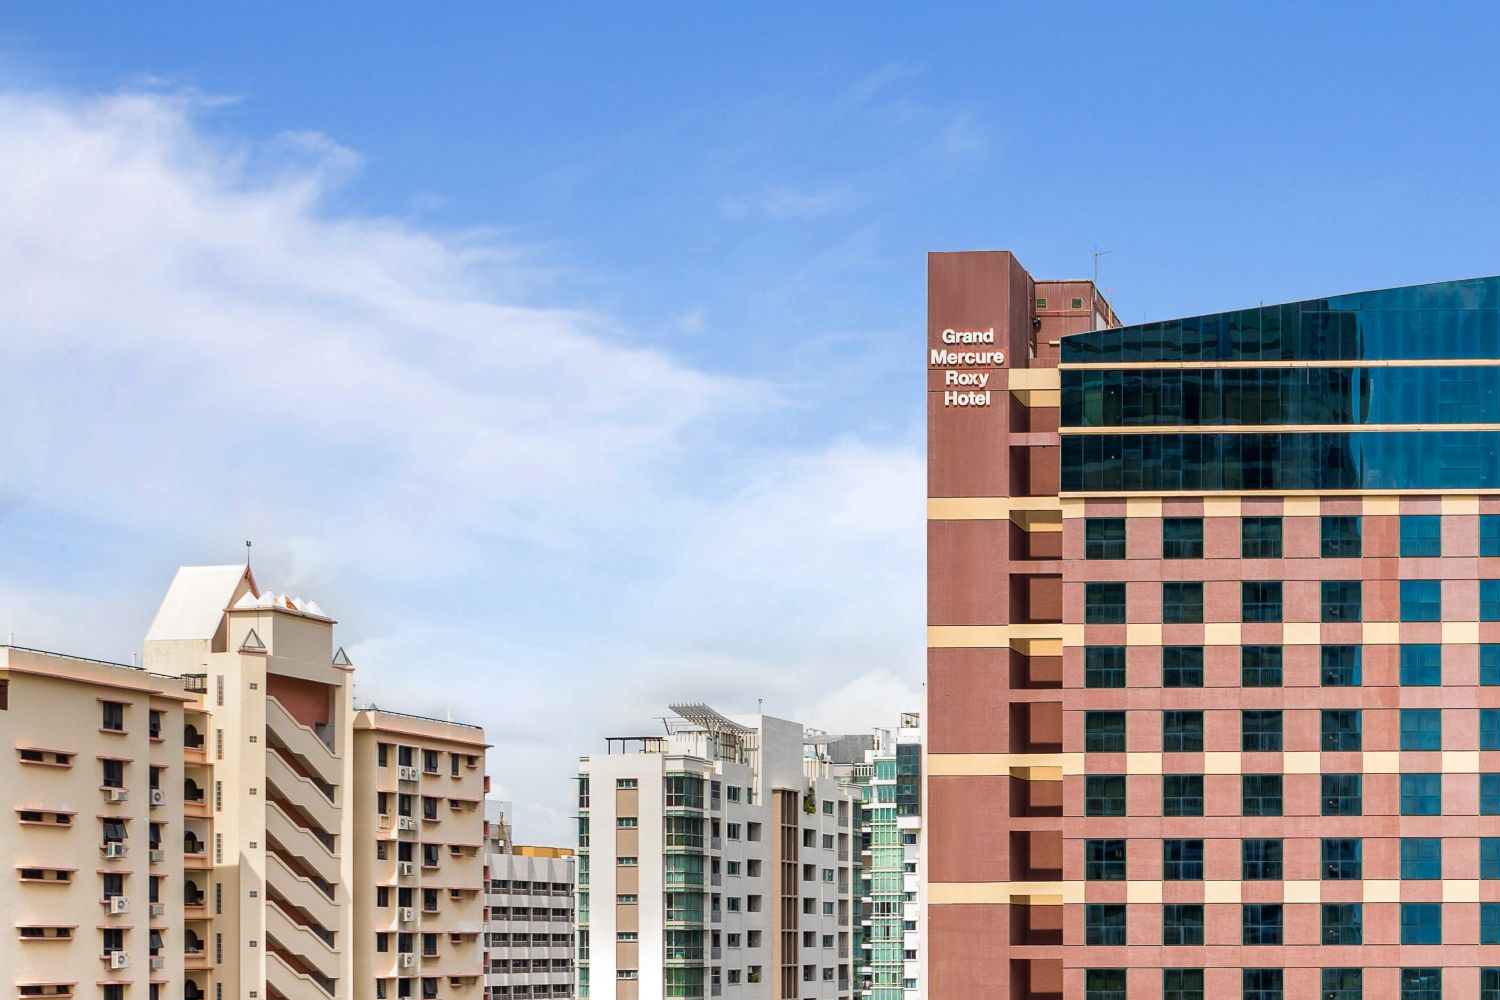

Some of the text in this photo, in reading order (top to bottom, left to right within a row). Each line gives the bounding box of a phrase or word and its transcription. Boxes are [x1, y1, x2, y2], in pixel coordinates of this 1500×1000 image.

[941, 328, 994, 344] Grand
[930, 349, 1004, 365] Mercure
[945, 370, 989, 387] Roxy
[944, 391, 991, 406] Hotel
